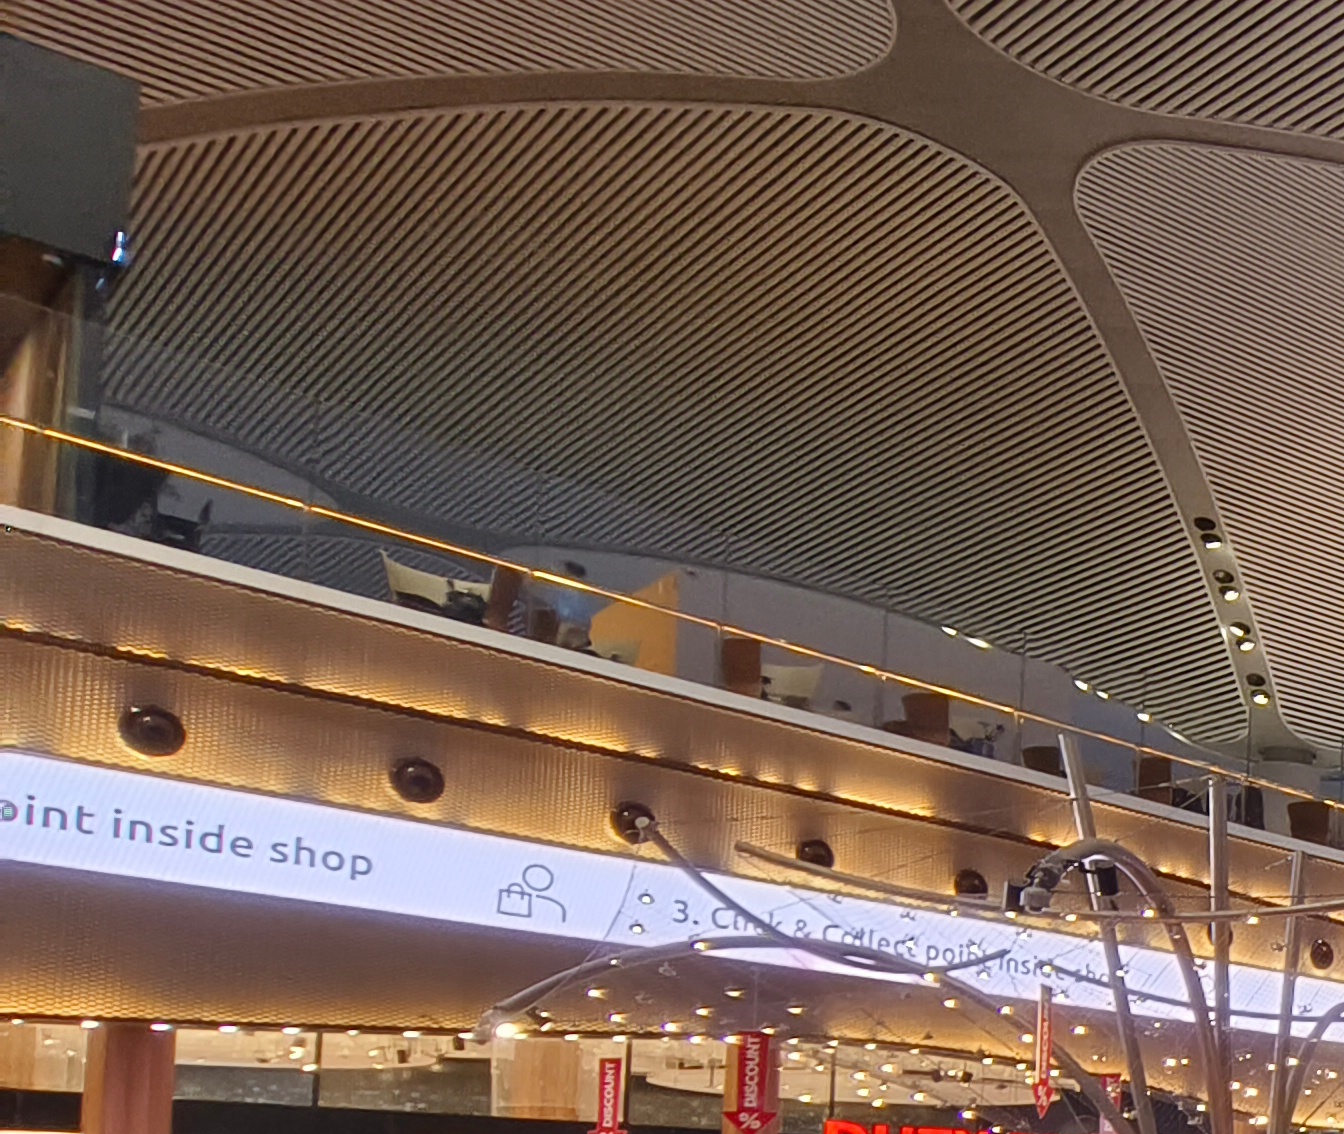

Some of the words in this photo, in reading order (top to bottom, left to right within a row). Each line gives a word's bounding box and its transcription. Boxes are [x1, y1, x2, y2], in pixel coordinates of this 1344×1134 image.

[112, 808, 254, 858] inside
[269, 836, 374, 881] shop
[672, 899, 700, 926] 3.
[793, 919, 812, 939] &
[602, 1062, 616, 1128] DISCOUNT
[745, 1036, 762, 1108] DISCOUNT
